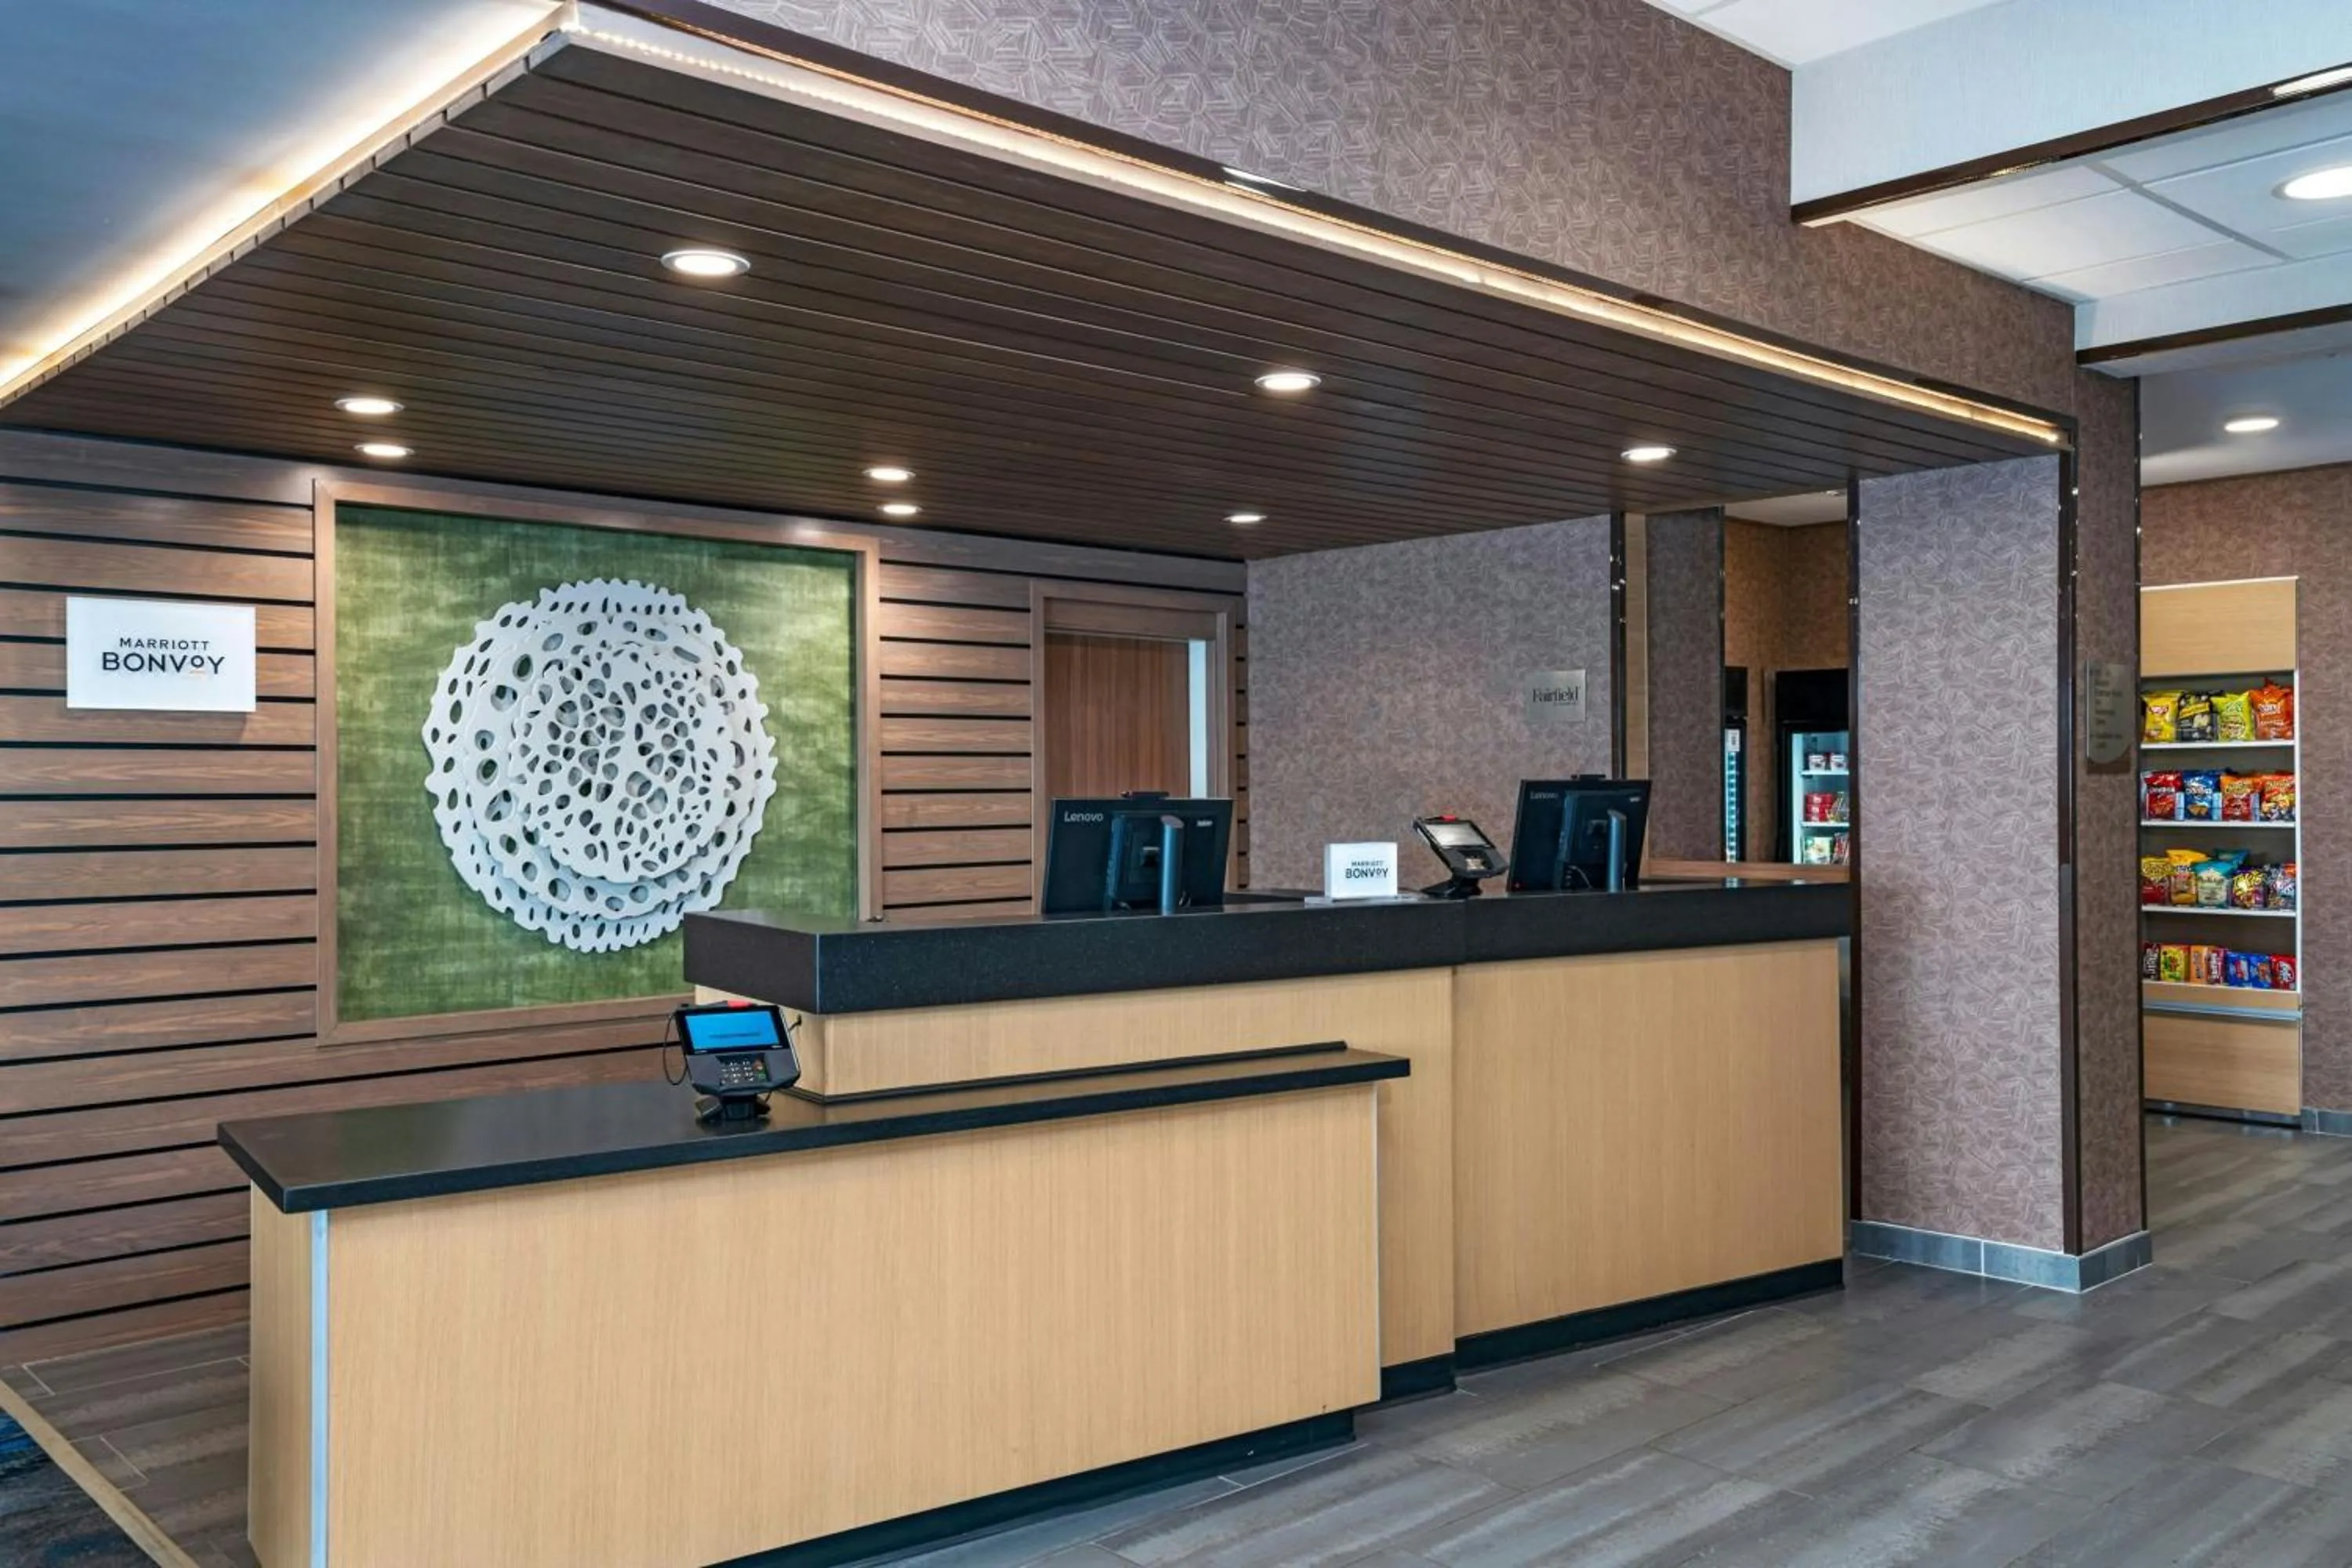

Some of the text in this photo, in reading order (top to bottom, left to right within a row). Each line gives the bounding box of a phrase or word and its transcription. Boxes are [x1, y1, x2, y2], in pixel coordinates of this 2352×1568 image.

[119, 637, 210, 651] MARRIOTT
[102, 652, 226, 675] BONVOY
[1064, 811, 1105, 822] Lenovo
